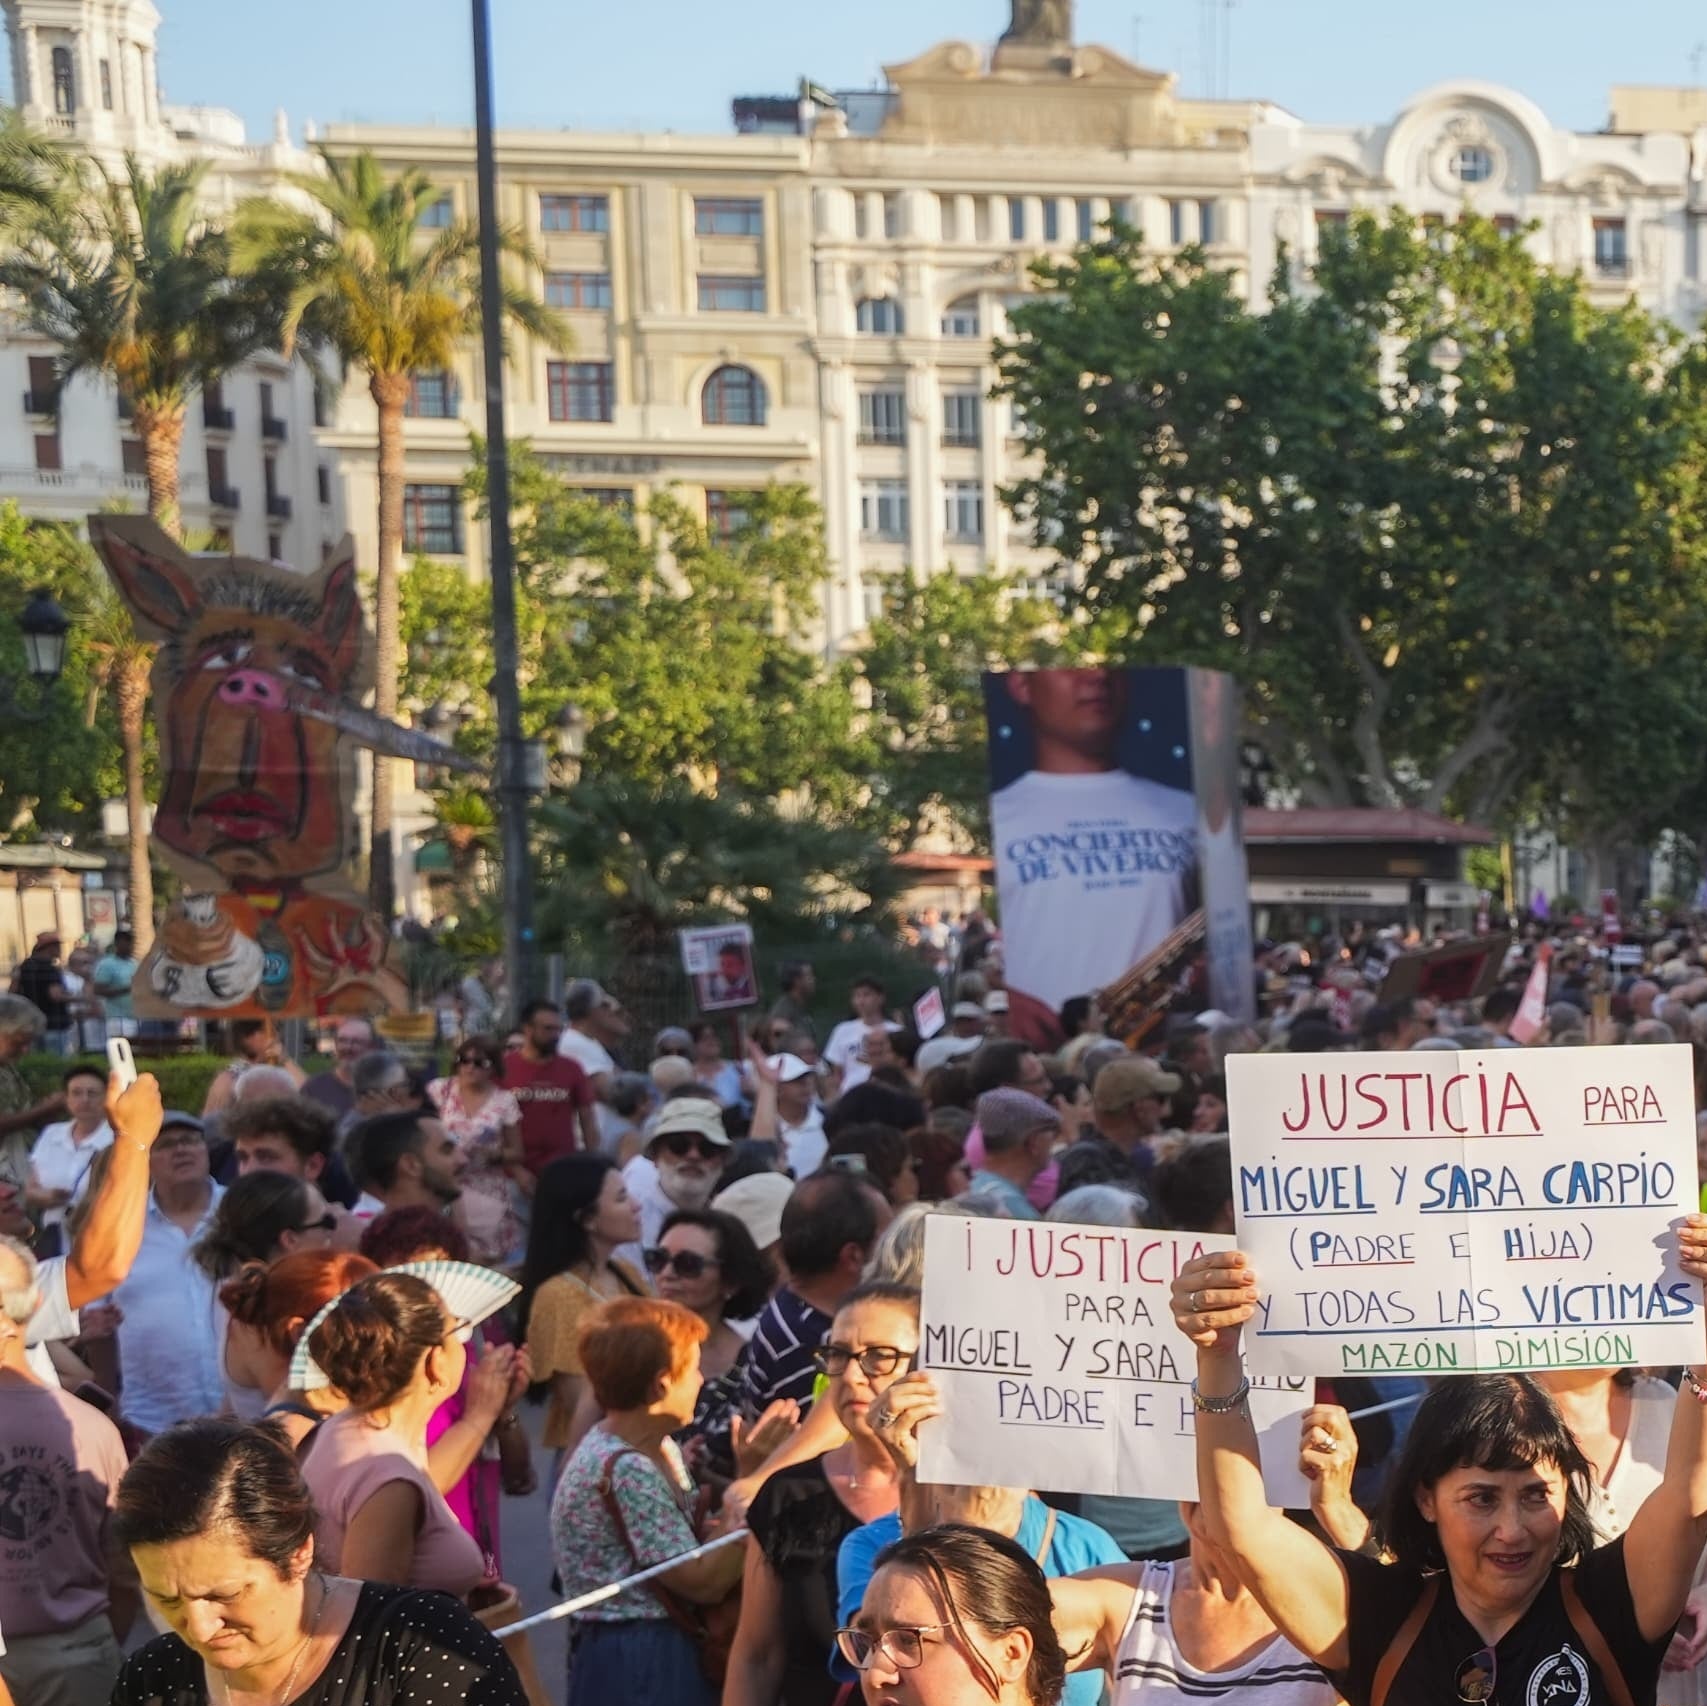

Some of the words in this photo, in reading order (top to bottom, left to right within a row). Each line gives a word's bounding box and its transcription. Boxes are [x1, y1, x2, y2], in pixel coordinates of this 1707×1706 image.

[1017, 857, 1058, 884] DE
[1282, 1062, 1541, 1134] JUSTICIA
[1584, 1085, 1664, 1121] PARA
[1241, 1156, 1375, 1212] MIGUEL
[1391, 1166, 1407, 1205] Y
[1420, 1162, 1525, 1209] SARA
[1543, 1152, 1675, 1206] CARPIO
[1450, 1233, 1470, 1259] E
[1065, 1293, 1154, 1327] PARA
[1257, 1294, 1273, 1330] Y
[1296, 1290, 1416, 1327] TODAS
[1438, 1289, 1500, 1325] LAS
[1522, 1272, 1695, 1322] VÍCTIMAS
[925, 1323, 1032, 1369] MIGUEL
[1055, 1333, 1075, 1371] Y
[1087, 1339, 1180, 1380] SARA
[1342, 1337, 1458, 1369] MAZÓN
[1496, 1330, 1633, 1368] DIMISIÓN
[998, 1380, 1105, 1424] PADRE
[1134, 1394, 1154, 1427] E
